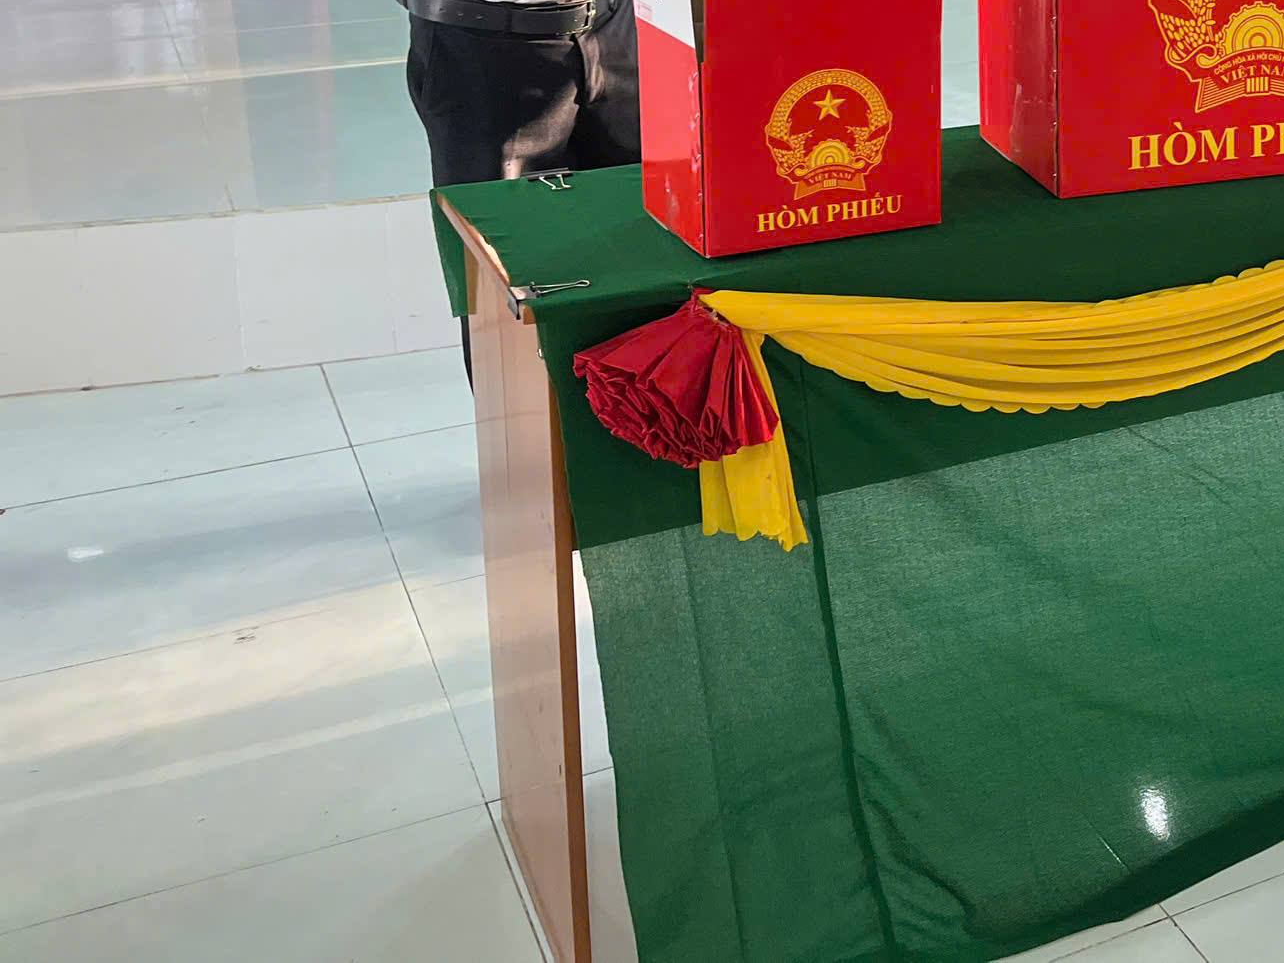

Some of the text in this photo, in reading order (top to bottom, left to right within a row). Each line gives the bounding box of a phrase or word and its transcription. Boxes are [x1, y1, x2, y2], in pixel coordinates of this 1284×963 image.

[1220, 64, 1256, 84] VIỆT
[1127, 121, 1240, 170] HÒM
[756, 192, 903, 232] HÒM PHIẾU
